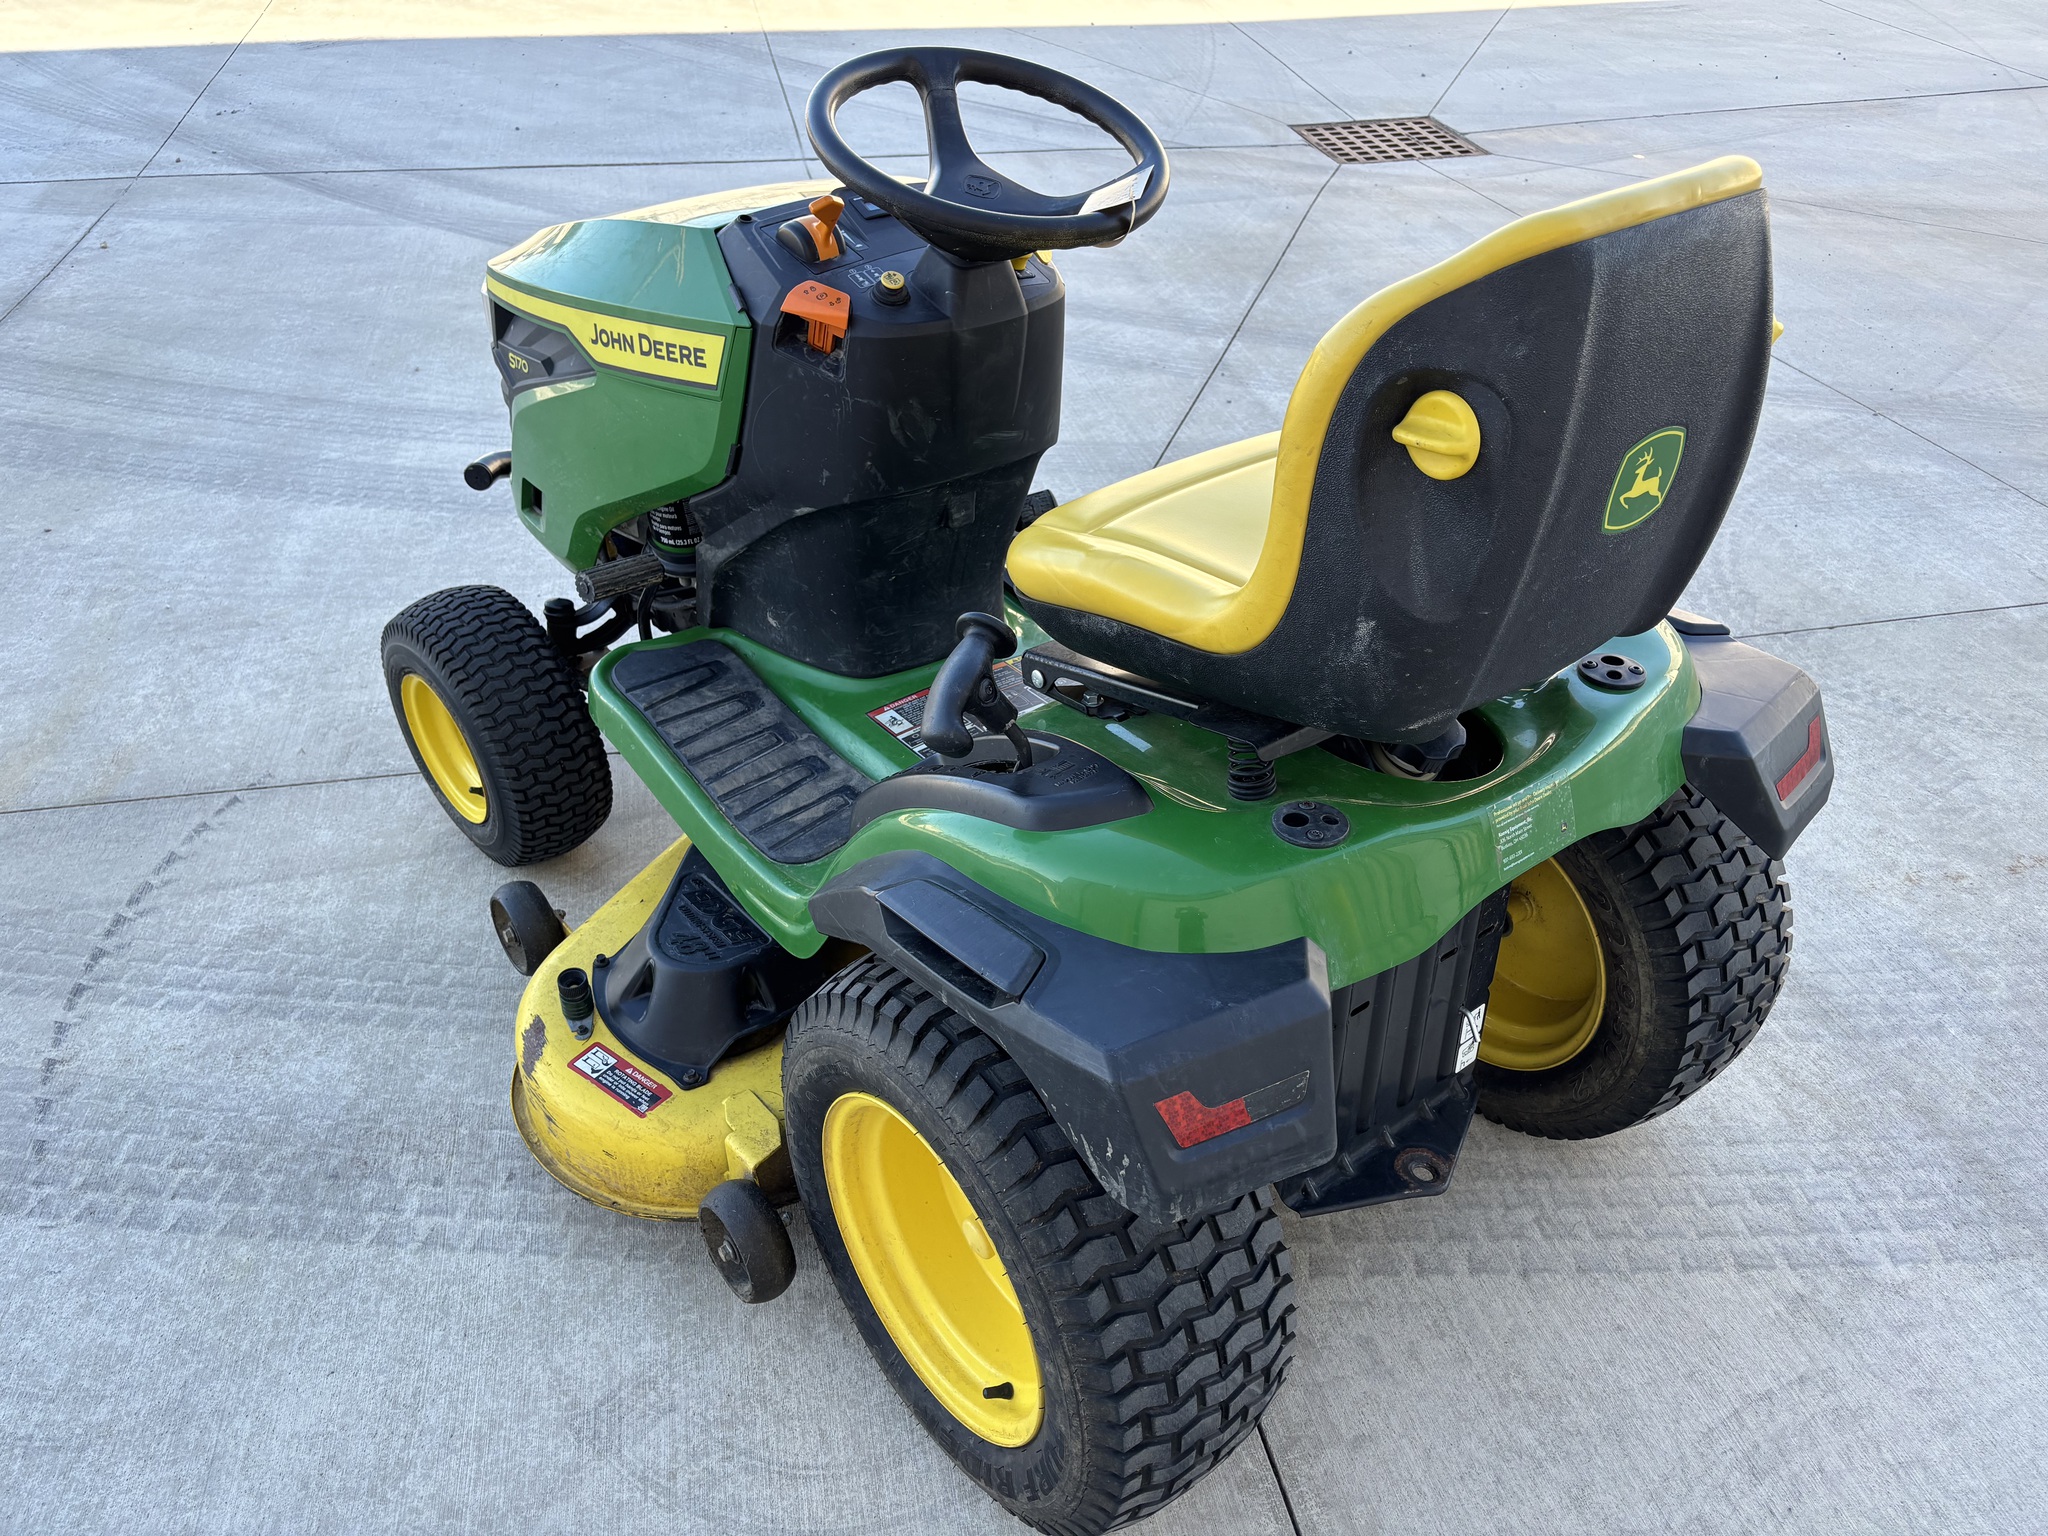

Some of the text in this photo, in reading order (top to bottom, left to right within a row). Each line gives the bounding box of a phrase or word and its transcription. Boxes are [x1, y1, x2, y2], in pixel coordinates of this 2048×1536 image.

[590, 323, 708, 369] JOHN DEERE
[508, 352, 530, 374] S170
[889, 694, 918, 709] DANGER
[614, 1069, 653, 1096] ROTATING BLADE
[632, 1071, 658, 1089] DANGER
